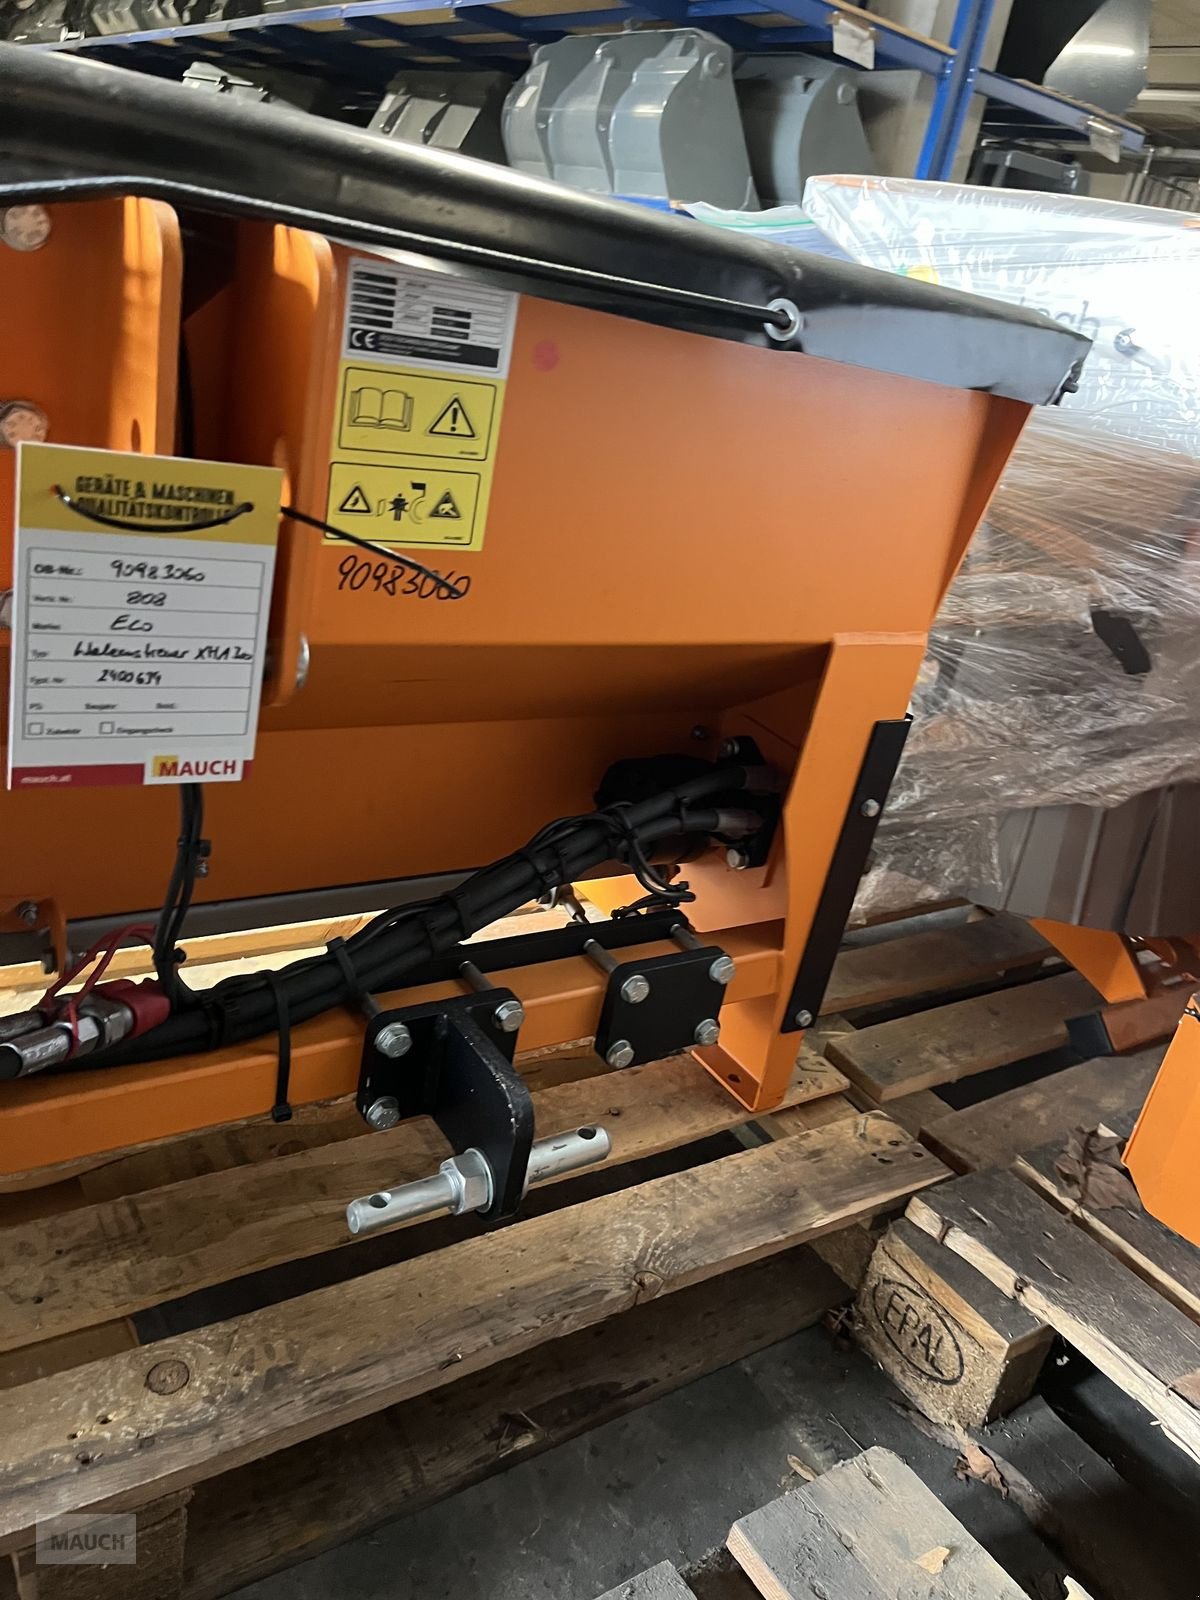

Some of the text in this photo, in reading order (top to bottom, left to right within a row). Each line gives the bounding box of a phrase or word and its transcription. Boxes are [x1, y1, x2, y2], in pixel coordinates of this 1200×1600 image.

[75, 473, 235, 505] GERÄTE & MASCHINEN
[110, 559, 206, 582] 90983060
[338, 554, 471, 601] 90983060
[159, 759, 237, 777] MAUCH
[882, 1289, 945, 1378] EPAL
